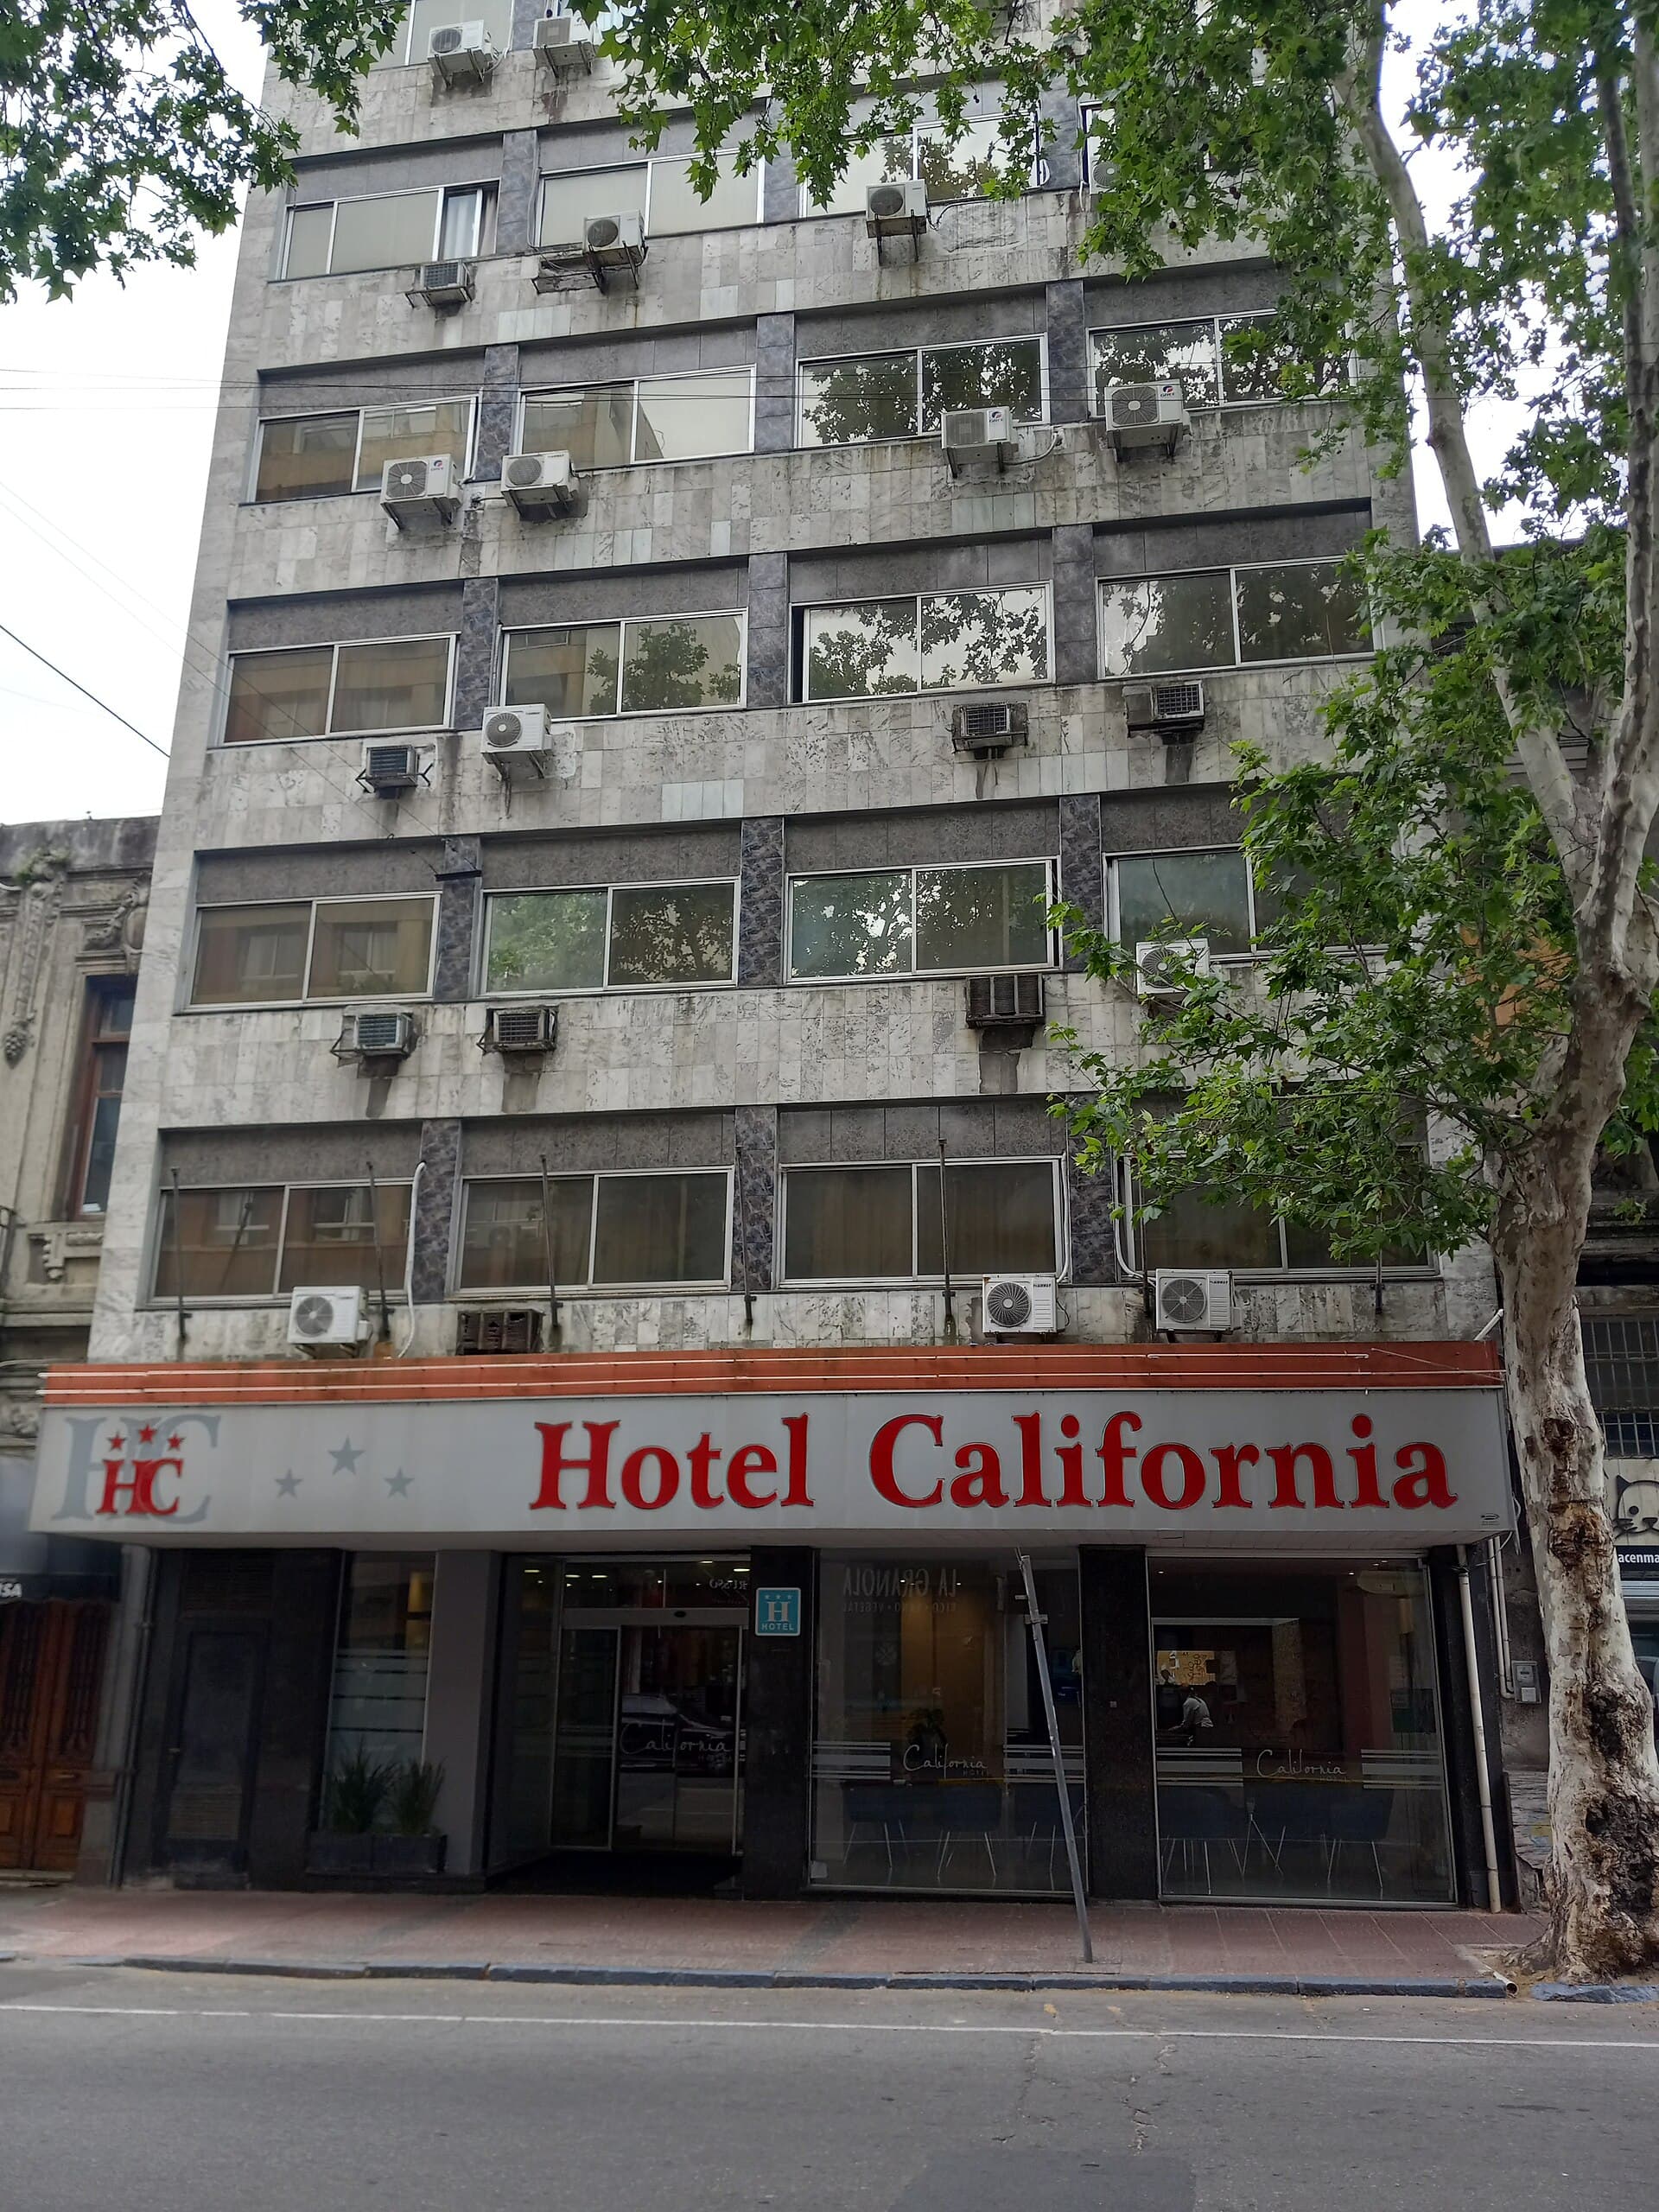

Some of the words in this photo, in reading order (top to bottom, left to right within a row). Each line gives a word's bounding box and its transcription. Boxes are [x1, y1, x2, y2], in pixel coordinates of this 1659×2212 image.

[529, 1412, 816, 1510] Hotel
[868, 1410, 1459, 1510] California
[95, 1457, 184, 1516] HC
[766, 1601, 791, 1622] H
[620, 1719, 733, 1769] California
[903, 1743, 988, 1779] California
[1256, 1748, 1347, 1777] California
